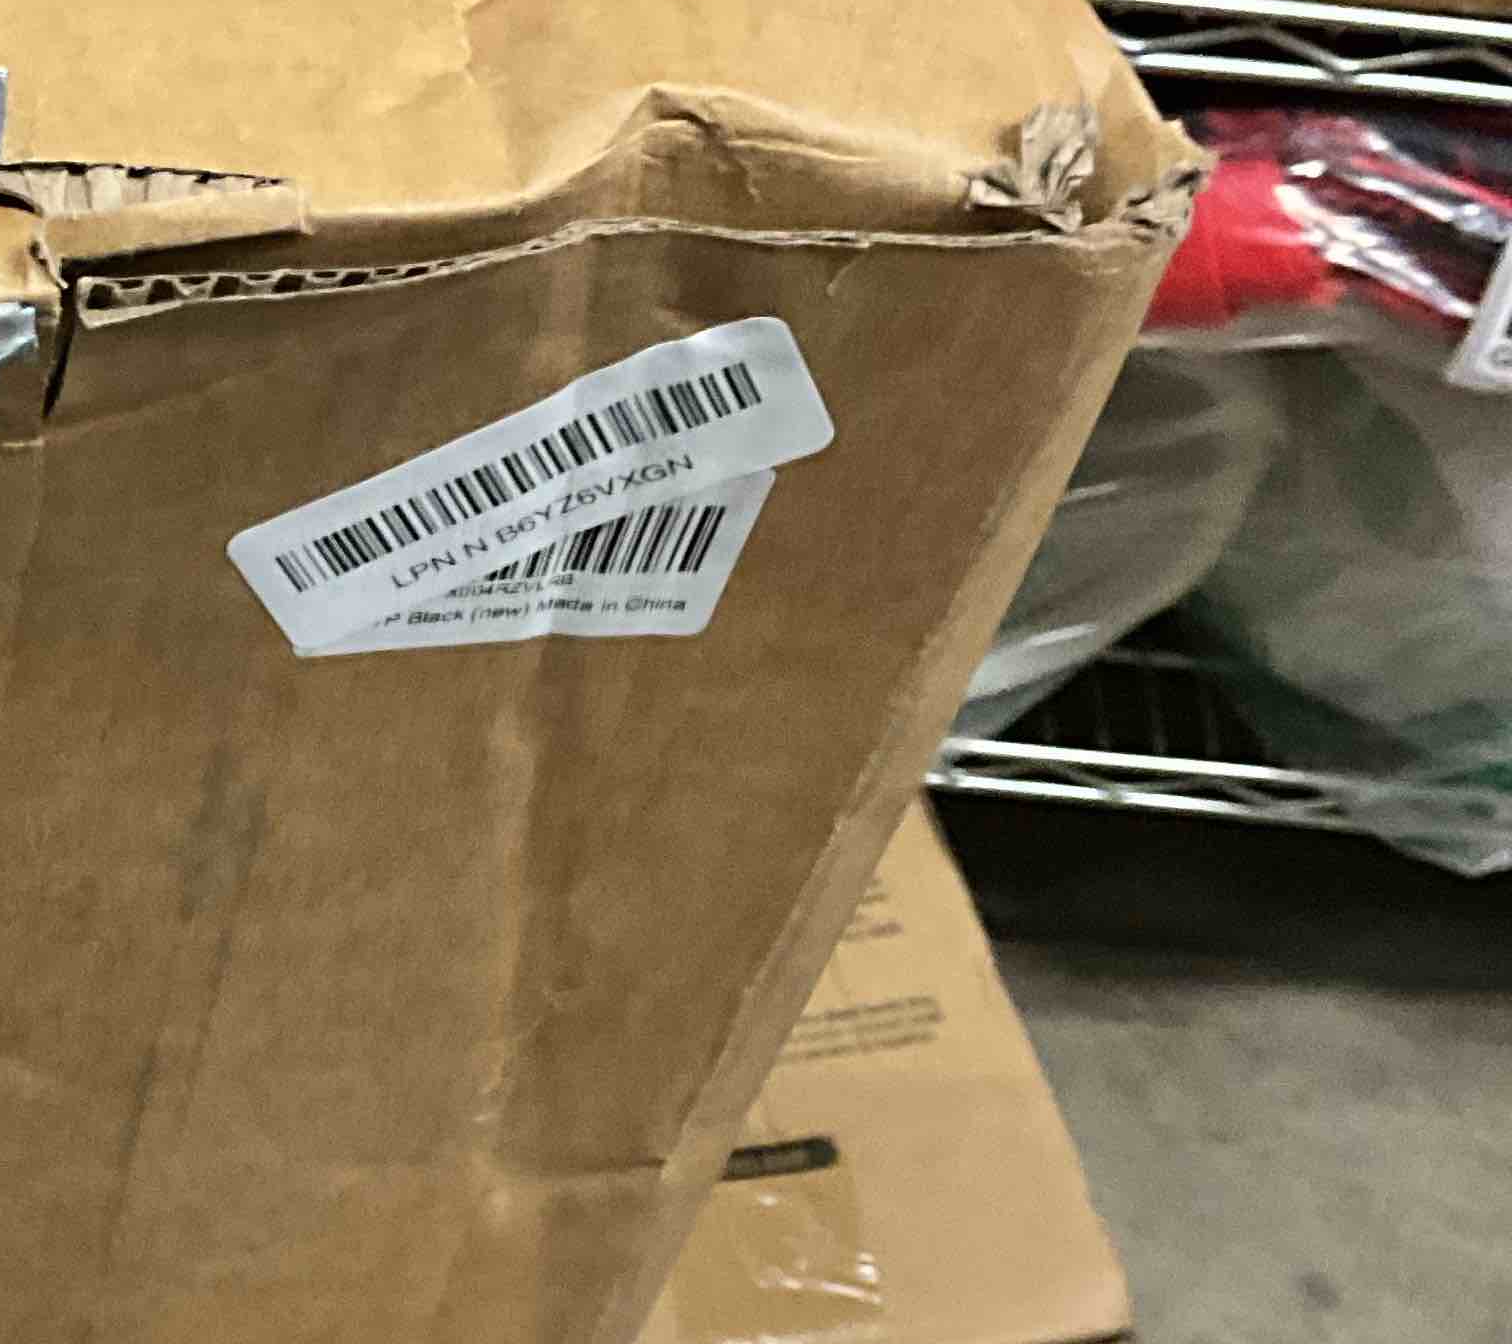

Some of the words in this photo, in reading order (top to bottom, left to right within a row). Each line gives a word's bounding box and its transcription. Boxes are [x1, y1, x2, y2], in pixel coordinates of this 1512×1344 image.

[391, 551, 458, 590] LPN
[463, 540, 489, 559] N
[407, 607, 465, 627] Black
[536, 596, 594, 615] Made
[625, 594, 687, 613] China
